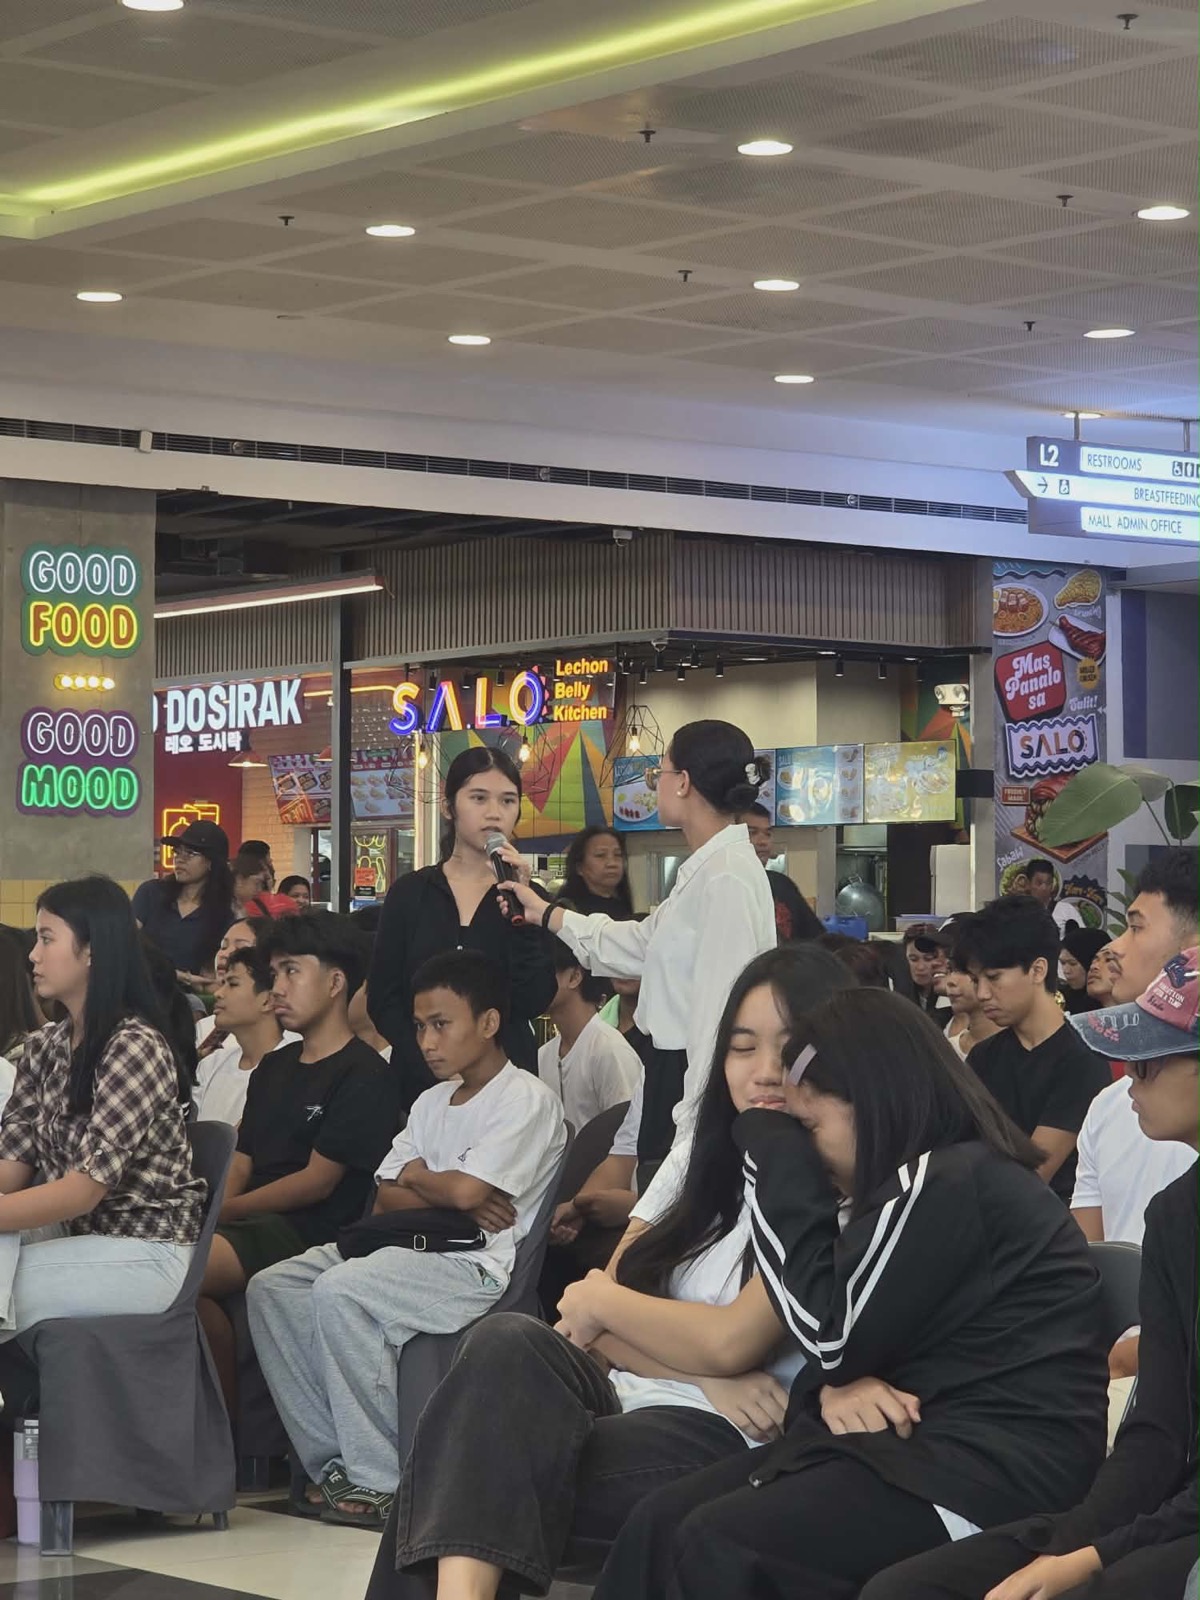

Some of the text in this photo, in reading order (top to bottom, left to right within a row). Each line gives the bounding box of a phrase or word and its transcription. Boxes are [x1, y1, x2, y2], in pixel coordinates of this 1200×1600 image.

[1039, 443, 1059, 467] L2
[1087, 453, 1142, 471] RESTROOMS
[1088, 515, 1182, 534] MALL ADMIN OFFICE
[29, 551, 136, 596] GOOD
[29, 601, 138, 649] FOOD
[556, 658, 609, 676] Lechon
[1012, 653, 1050, 679] Mas
[554, 681, 590, 701] Belly
[1005, 666, 1061, 700] Panalo
[167, 679, 302, 734] DOSIRAK
[1028, 692, 1046, 710] sa
[553, 705, 607, 722] Kitchen
[27, 712, 135, 757] GOOD
[165, 730, 242, 754] 레오 도시락
[22, 765, 138, 810] MOOD
